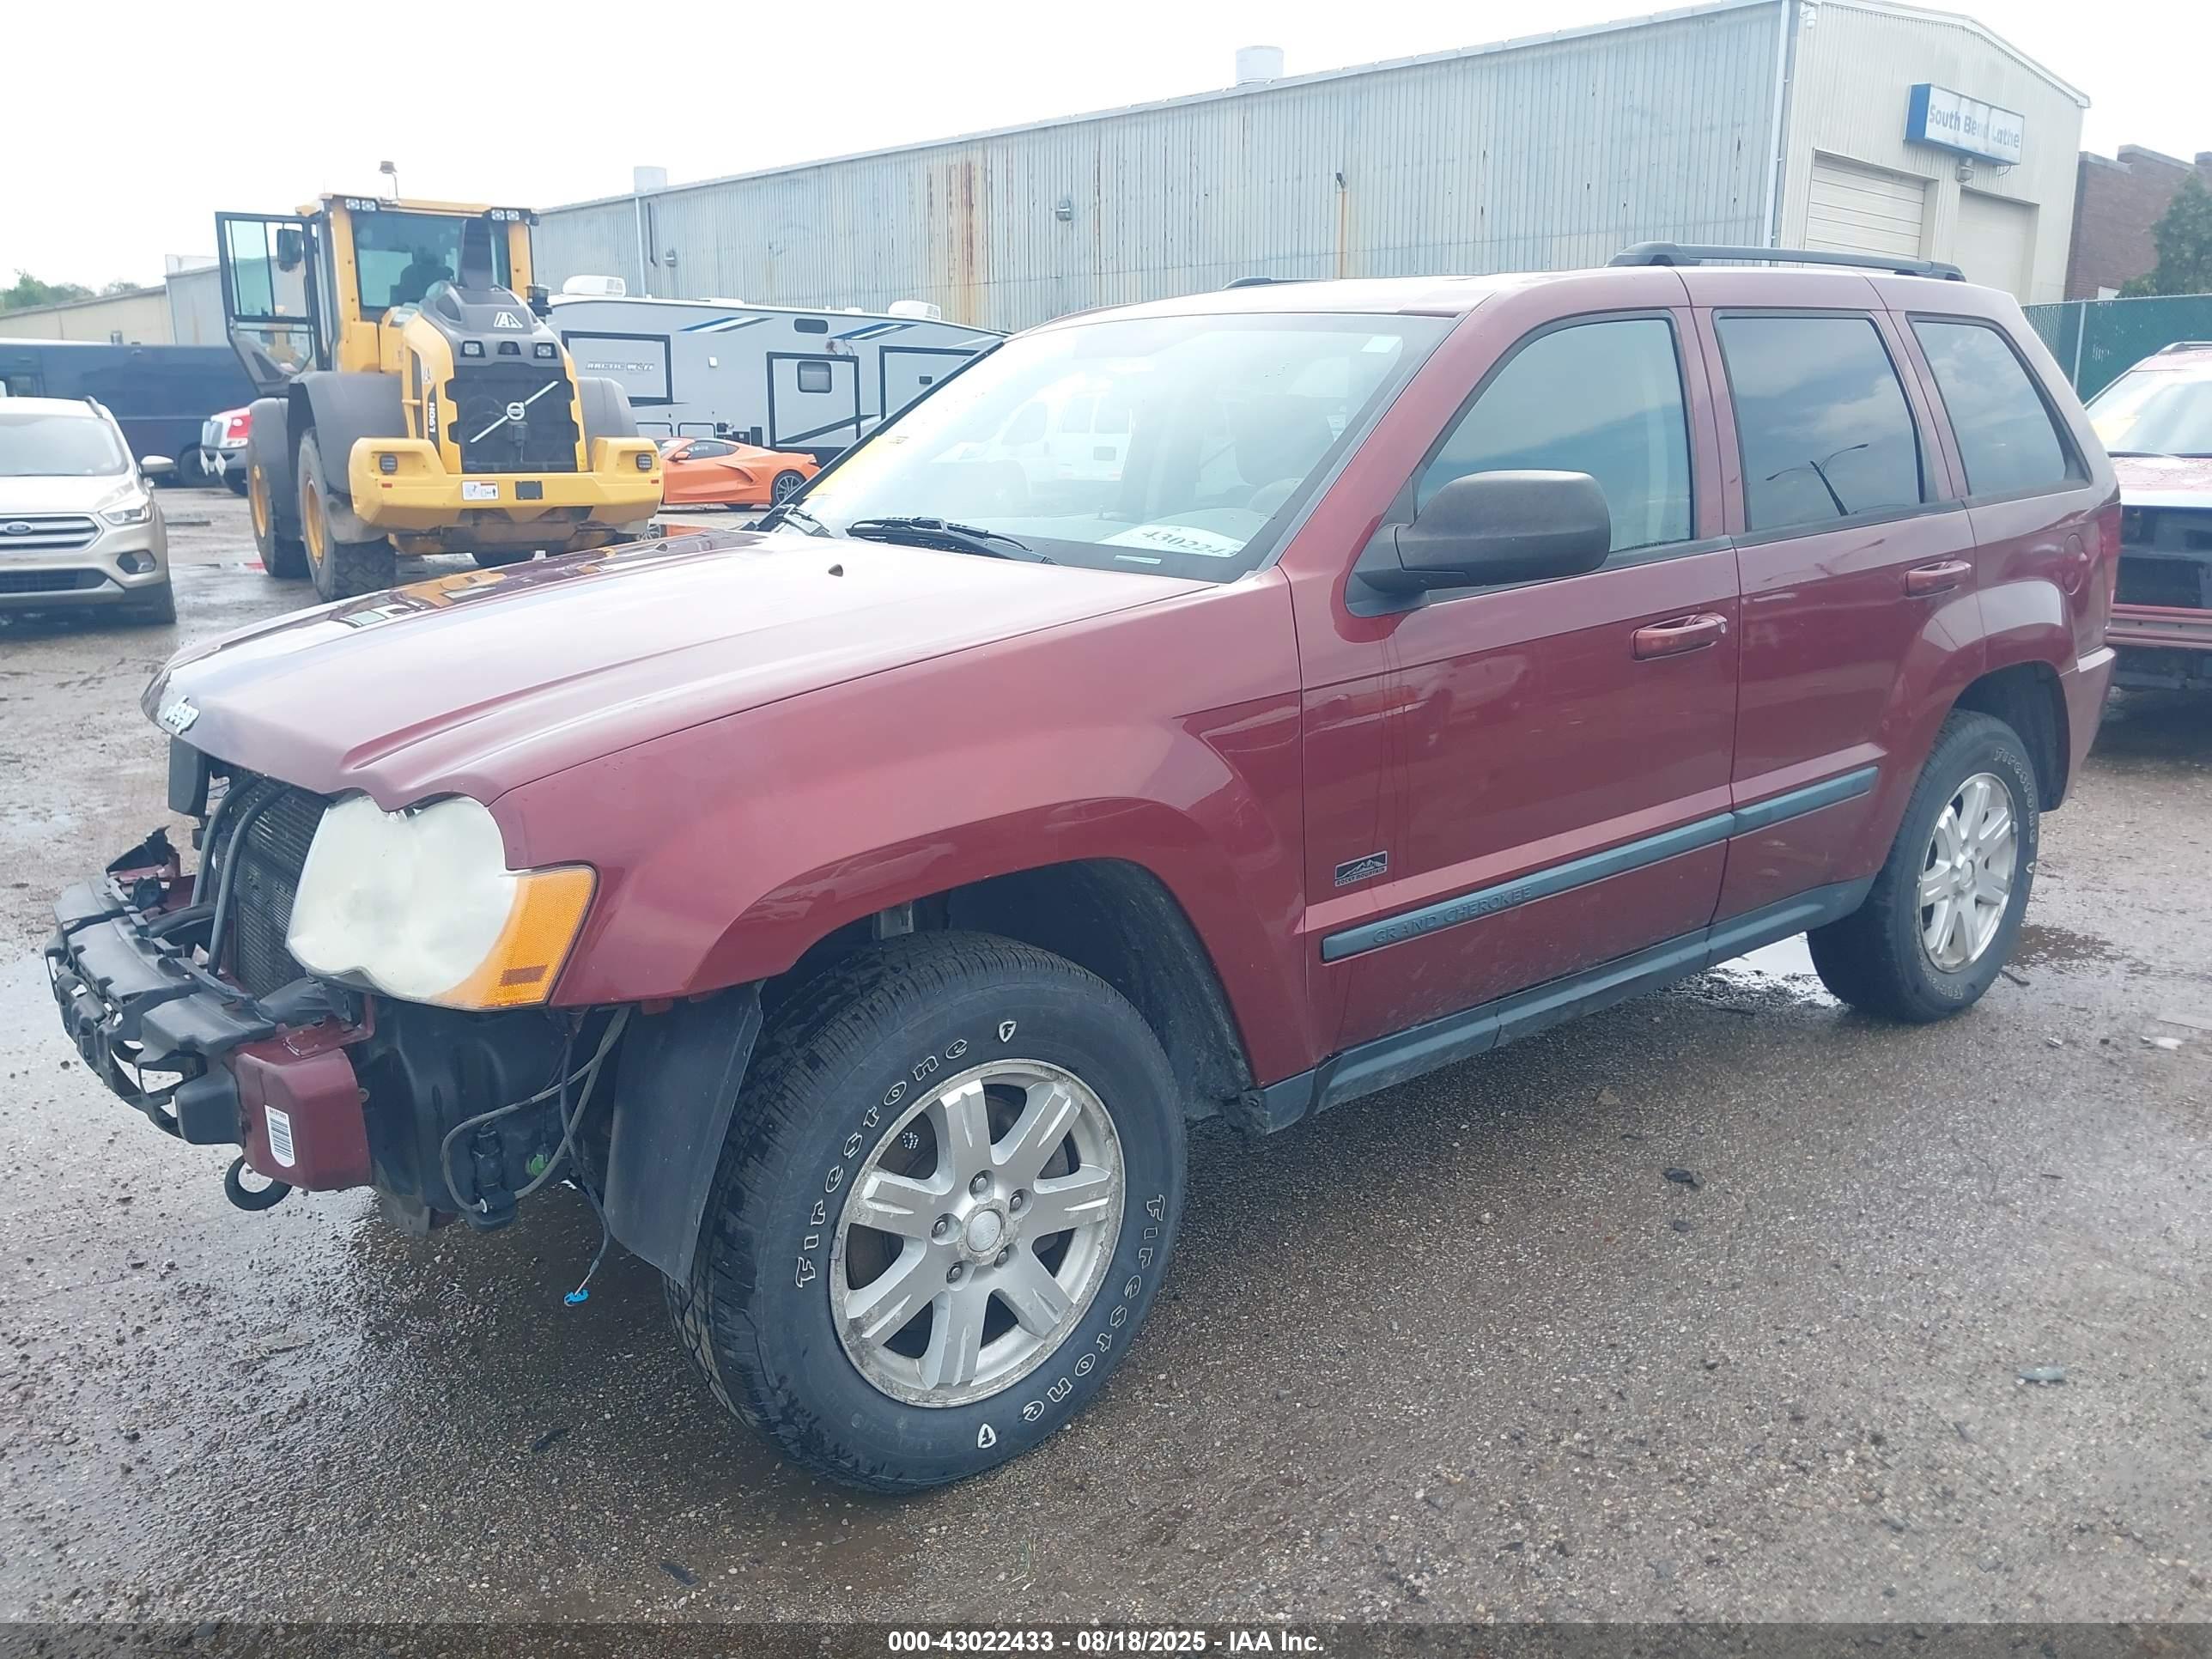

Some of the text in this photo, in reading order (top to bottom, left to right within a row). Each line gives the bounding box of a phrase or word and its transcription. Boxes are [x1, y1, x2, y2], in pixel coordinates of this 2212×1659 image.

[1929, 104, 1961, 131] South
[164, 694, 201, 735] Jeep
[1993, 747, 2038, 844] Firestone
[1373, 885, 1533, 944] GRAND CHEROKEE
[795, 1038, 969, 1288] Firestone
[1022, 1194, 1166, 1422] Firestone
